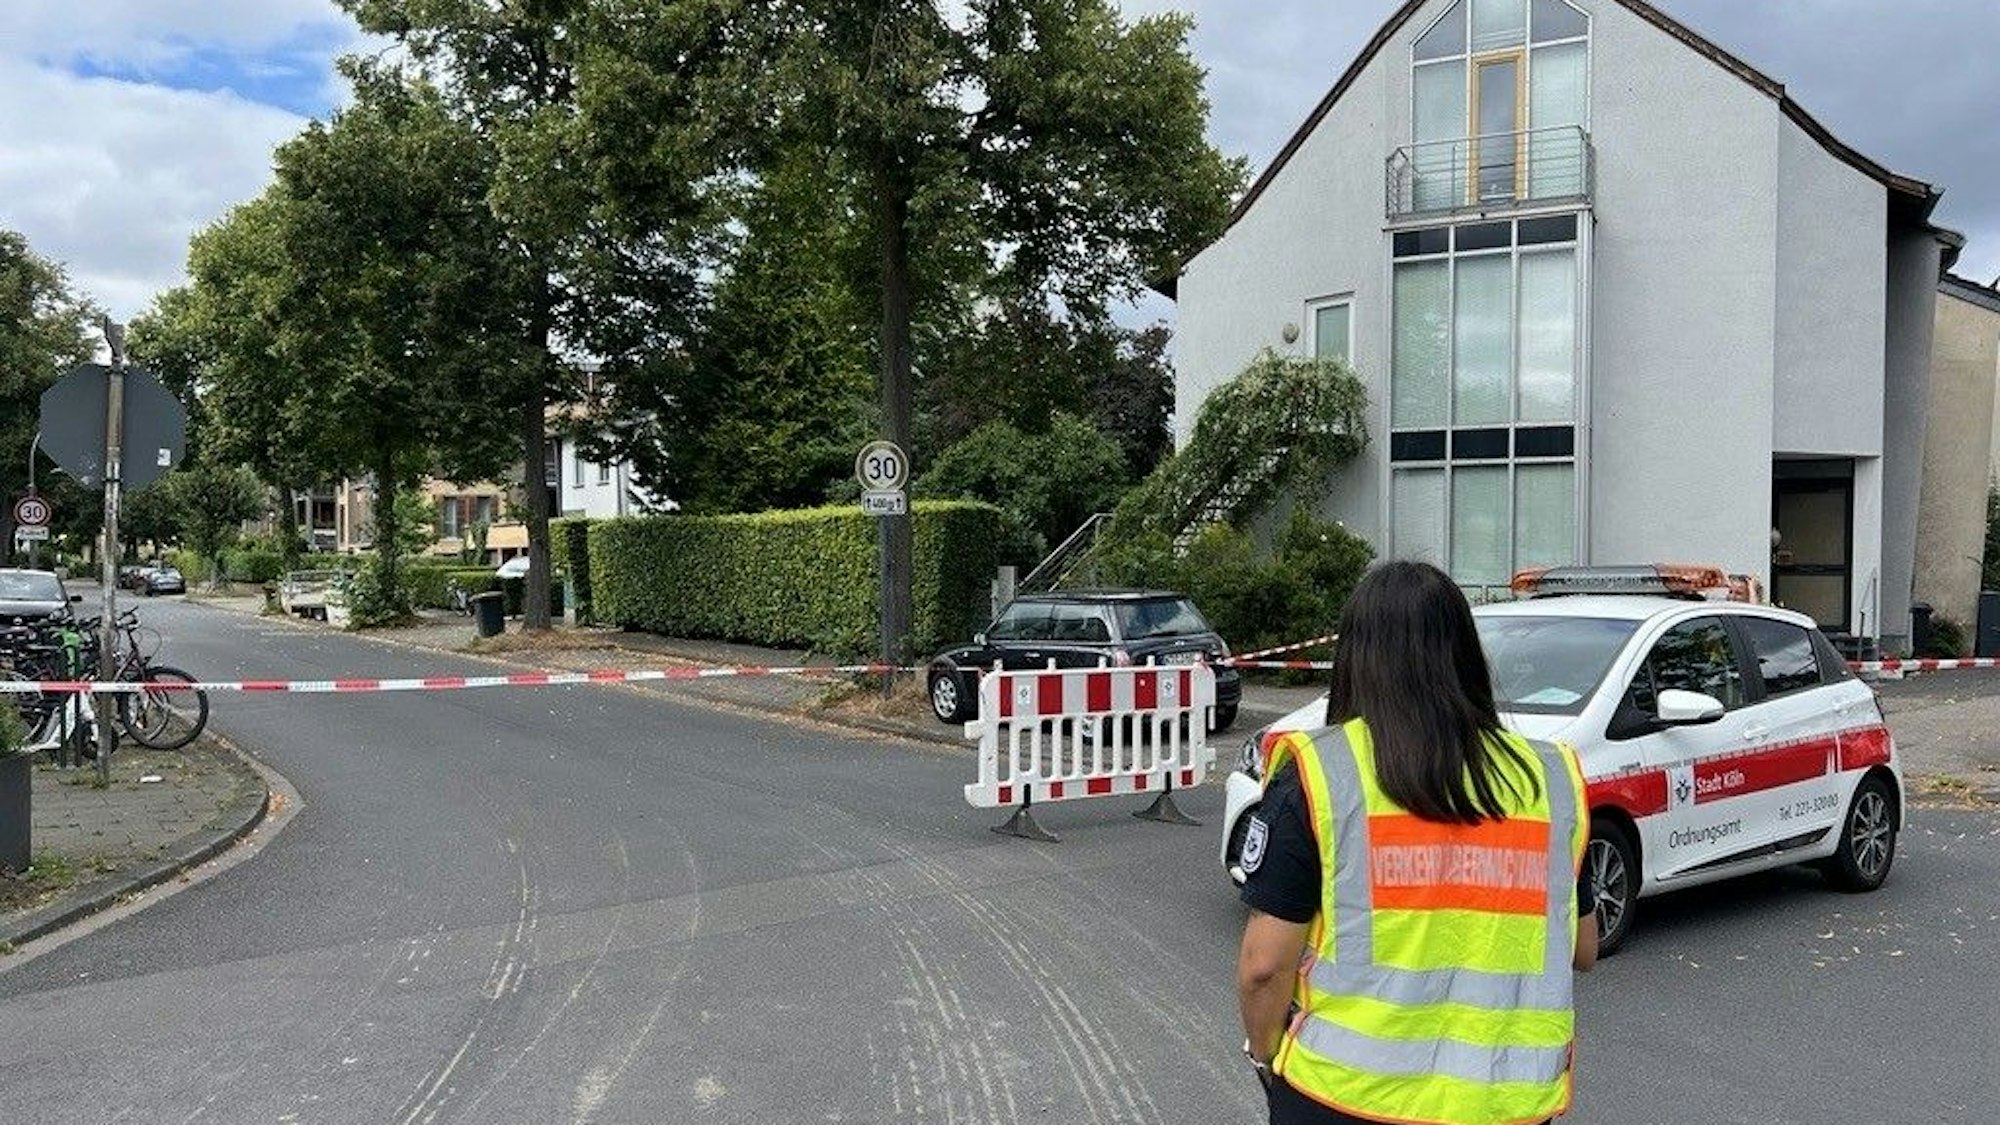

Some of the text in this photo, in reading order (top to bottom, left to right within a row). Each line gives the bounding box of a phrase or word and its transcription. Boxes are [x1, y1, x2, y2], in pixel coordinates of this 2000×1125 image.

[869, 457, 897, 480] 30
[23, 505, 42, 519] 30
[1696, 768, 1745, 795] Stadt Köln
[1669, 819, 1742, 848] Ordnungsamt
